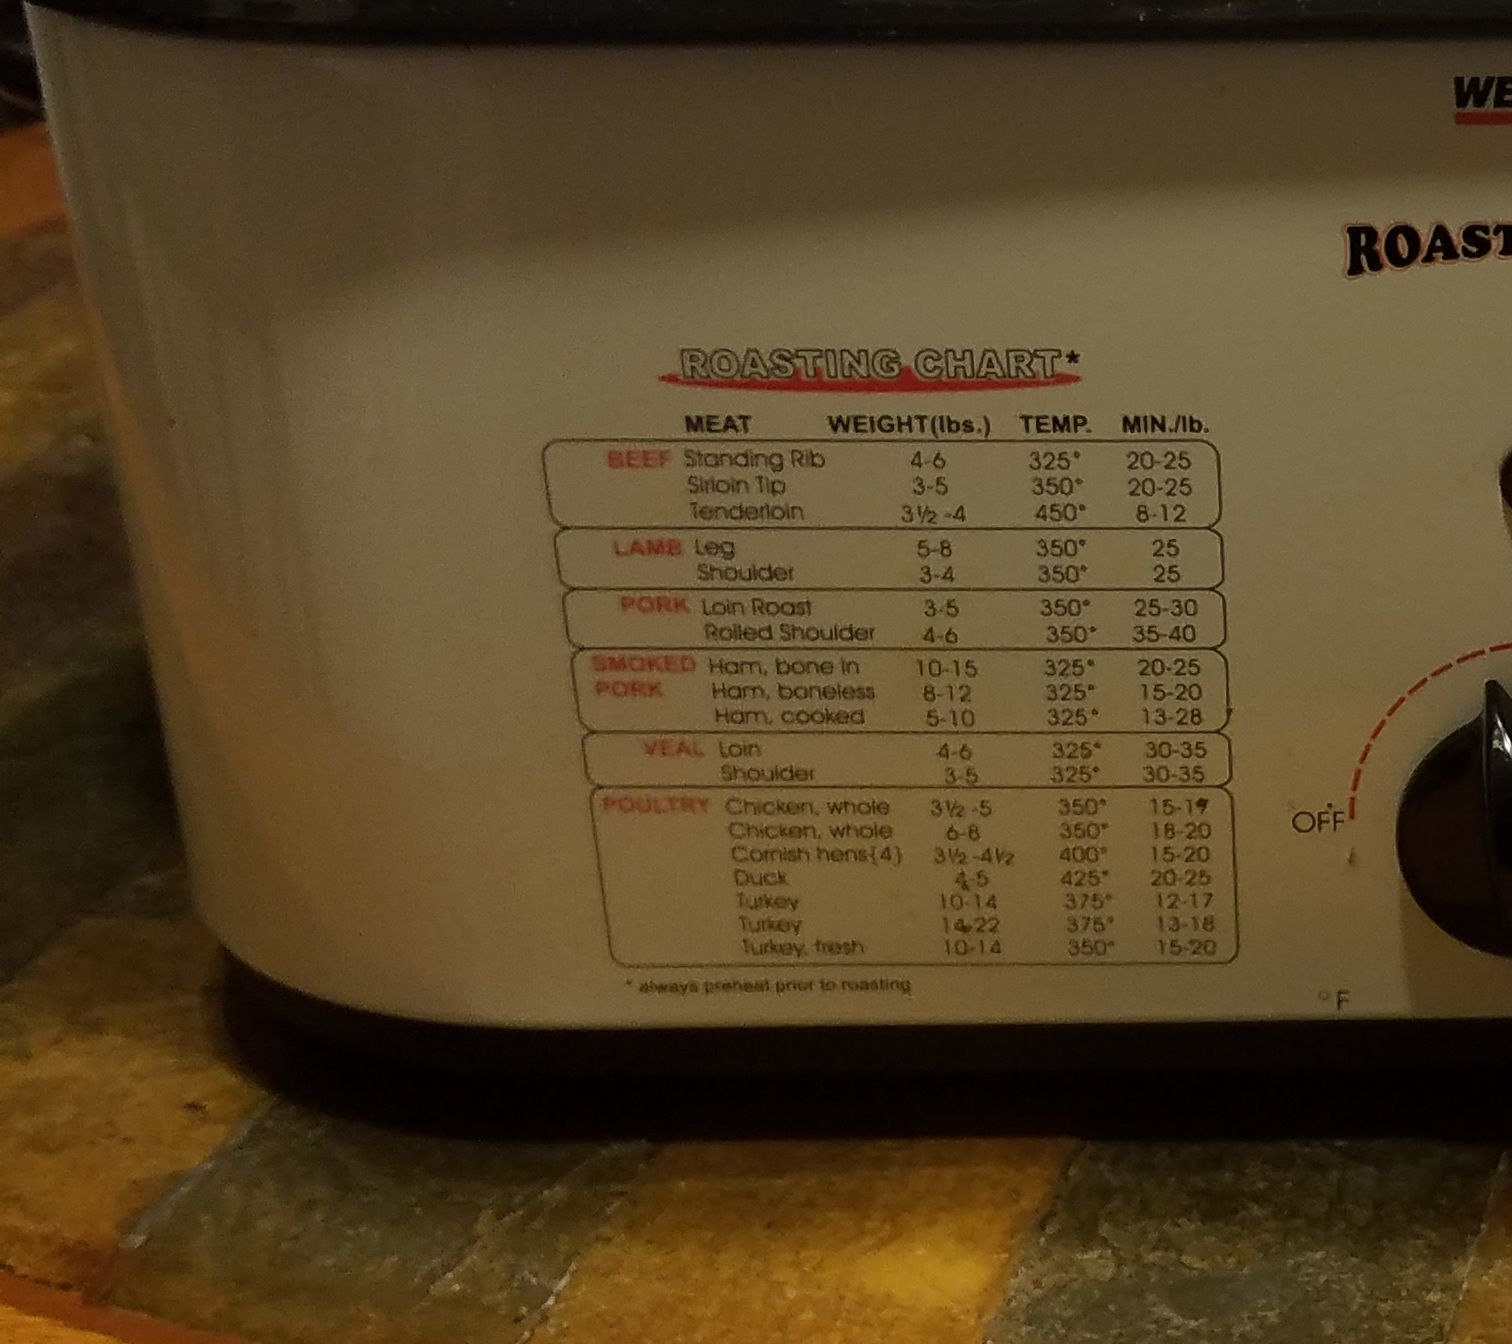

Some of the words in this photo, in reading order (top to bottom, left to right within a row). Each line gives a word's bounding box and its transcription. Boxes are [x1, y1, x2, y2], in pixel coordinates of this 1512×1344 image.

[679, 348, 900, 380] ROASTING
[685, 415, 752, 433] MEAT
[828, 414, 991, 439] WEIGHT(lbs.)
[1019, 415, 1092, 434] TEMP.
[1122, 415, 1210, 434] MIN./lb.
[607, 450, 671, 468] BEEF
[684, 450, 786, 470] Standing
[792, 450, 825, 469] Rib
[911, 451, 946, 469] 4-6
[1127, 451, 1191, 470] 20-25
[686, 475, 752, 495] Sirloin
[758, 475, 787, 497] Tip
[912, 477, 949, 495] 3-5
[1128, 476, 1192, 496] 20-25
[689, 502, 804, 522] Tenderloin
[1136, 504, 1187, 523] 8-12
[614, 539, 682, 556] LAMB
[695, 538, 735, 561] Leg
[917, 539, 952, 557] 5-8
[1152, 539, 1180, 557] 25
[697, 563, 794, 583] Shoulder
[919, 565, 955, 583] 3-4
[1154, 564, 1181, 583] 25
[621, 598, 689, 615] PORK
[702, 597, 746, 616] Loin
[752, 597, 812, 616] Roast
[924, 599, 959, 617] 3-5
[1134, 598, 1198, 617] 25-30
[704, 624, 774, 643] Rolled
[780, 622, 875, 643] Shoulder
[922, 626, 958, 644] 4-6
[1133, 624, 1196, 644] 35-40
[592, 655, 695, 674] SMOKED
[708, 657, 769, 679] Ham,
[775, 657, 834, 677] bone
[840, 657, 859, 676] in
[915, 658, 978, 678] 10-15
[1138, 657, 1200, 676] 20-25
[596, 681, 662, 697] PORK
[711, 683, 771, 704] Ham,
[777, 682, 876, 702] boneless
[923, 683, 972, 703] 8-12
[1140, 682, 1203, 702] 15-20
[714, 707, 773, 728] Ham,
[781, 707, 865, 726] cooked
[926, 708, 976, 727] 5-10
[1141, 707, 1203, 726] 13-28
[644, 739, 704, 757] VEAL
[719, 739, 762, 759] Loin
[937, 742, 973, 760] 4-6
[1145, 741, 1207, 760] 30-35
[720, 764, 815, 783] Shoulder
[944, 766, 978, 785] 3-5
[1142, 765, 1205, 785] 30-35
[601, 797, 711, 814] POULTRY
[826, 798, 889, 817] whole
[829, 821, 893, 840] whole
[945, 822, 981, 841] 6-8
[1150, 822, 1212, 841] 18-20
[1292, 811, 1344, 833] OFF
[1151, 845, 1211, 864] 15-20
[734, 868, 788, 887] Duck
[1150, 868, 1211, 887] 20-25
[736, 892, 799, 913] Turkey
[940, 893, 998, 911] 10-14
[1155, 893, 1214, 911] 12-17
[739, 915, 803, 936] Turkey
[814, 937, 865, 956] fresh
[943, 939, 1002, 956] 10-14
[1156, 938, 1217, 957] 15-20
[639, 979, 699, 996] always
[703, 979, 770, 994] preheat
[819, 979, 835, 993] to
[840, 978, 911, 996] roasting
